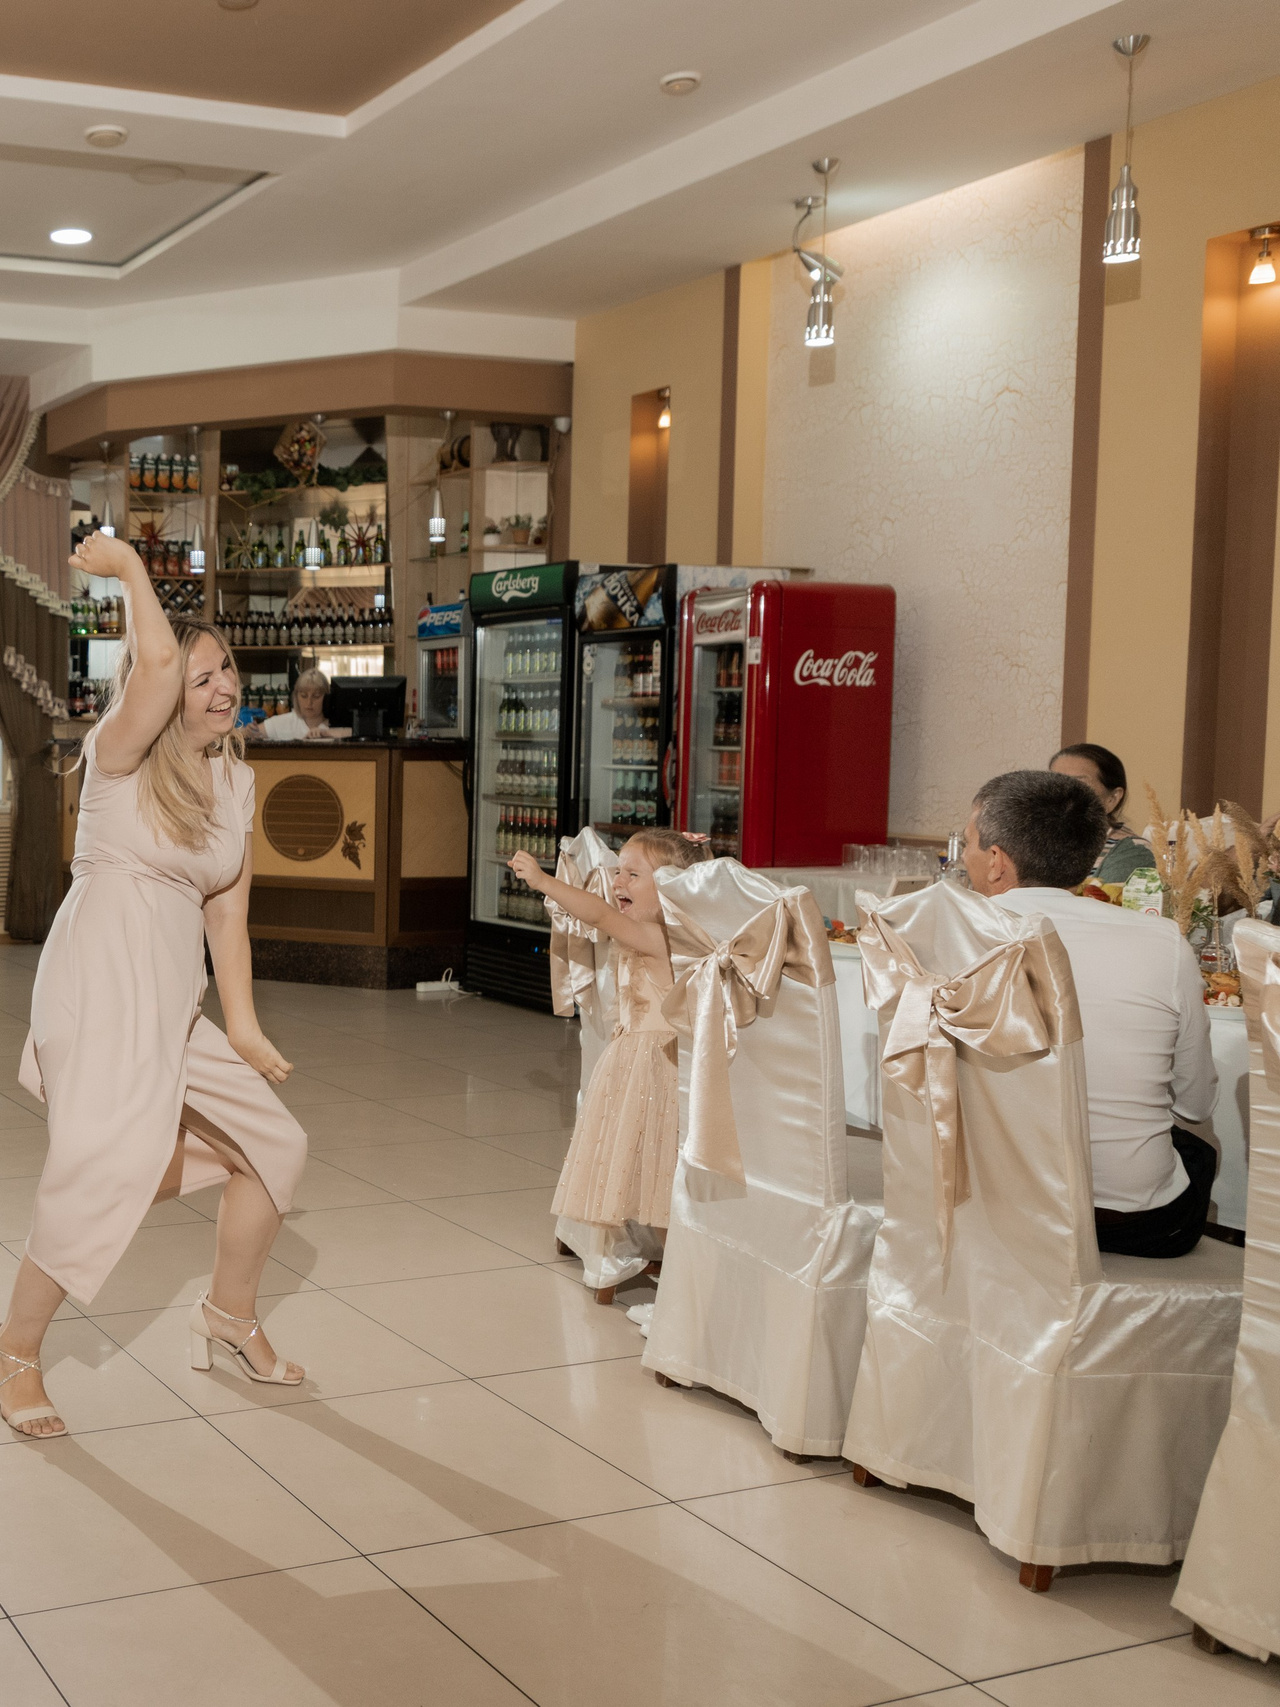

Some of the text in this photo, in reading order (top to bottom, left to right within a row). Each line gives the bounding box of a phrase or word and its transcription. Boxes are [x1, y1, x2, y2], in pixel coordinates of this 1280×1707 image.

[491, 571, 540, 602] Carlsberg
[696, 608, 743, 635] Coca-Cola
[794, 649, 879, 687] Coca-Cola
